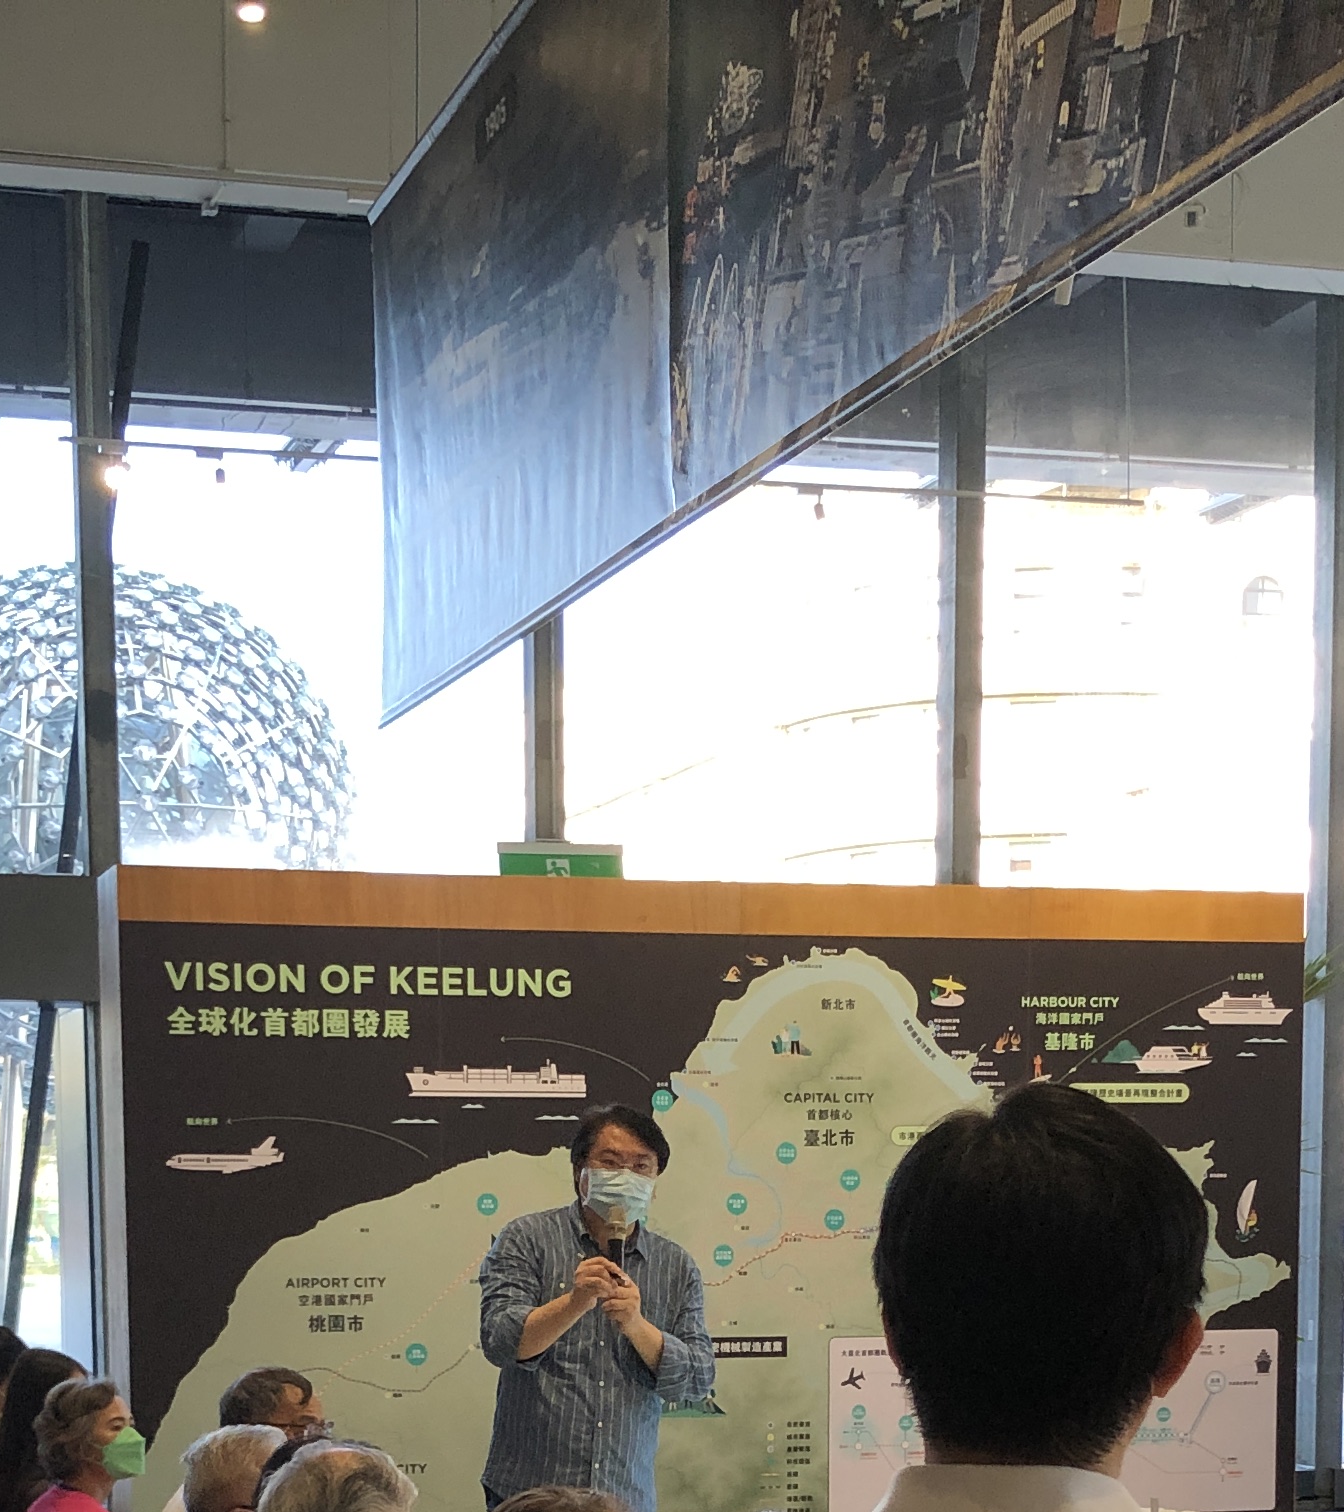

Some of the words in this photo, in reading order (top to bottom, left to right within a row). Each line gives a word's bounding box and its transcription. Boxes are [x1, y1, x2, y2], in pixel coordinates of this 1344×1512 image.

[164, 960, 306, 994] VISION
[320, 965, 376, 996] OF
[389, 966, 572, 999] KEELUNG
[821, 998, 856, 1011] 新北市
[1021, 996, 1087, 1008] HARBOUR
[1090, 996, 1120, 1008] CITY
[167, 1006, 411, 1039] 全球化首都圈發展
[1035, 1012, 1105, 1026] 海洋國家門戶
[1044, 1032, 1096, 1051] 基隆市
[784, 1092, 841, 1104] CAPITAL
[844, 1092, 875, 1103] CITY
[807, 1108, 853, 1121] 首都核心
[804, 1128, 855, 1147] 臺北市
[285, 1276, 350, 1290] AIRPORT
[354, 1276, 387, 1289] CITY
[297, 1293, 375, 1307] 空港國家門戶
[308, 1313, 365, 1334] 桃園市
